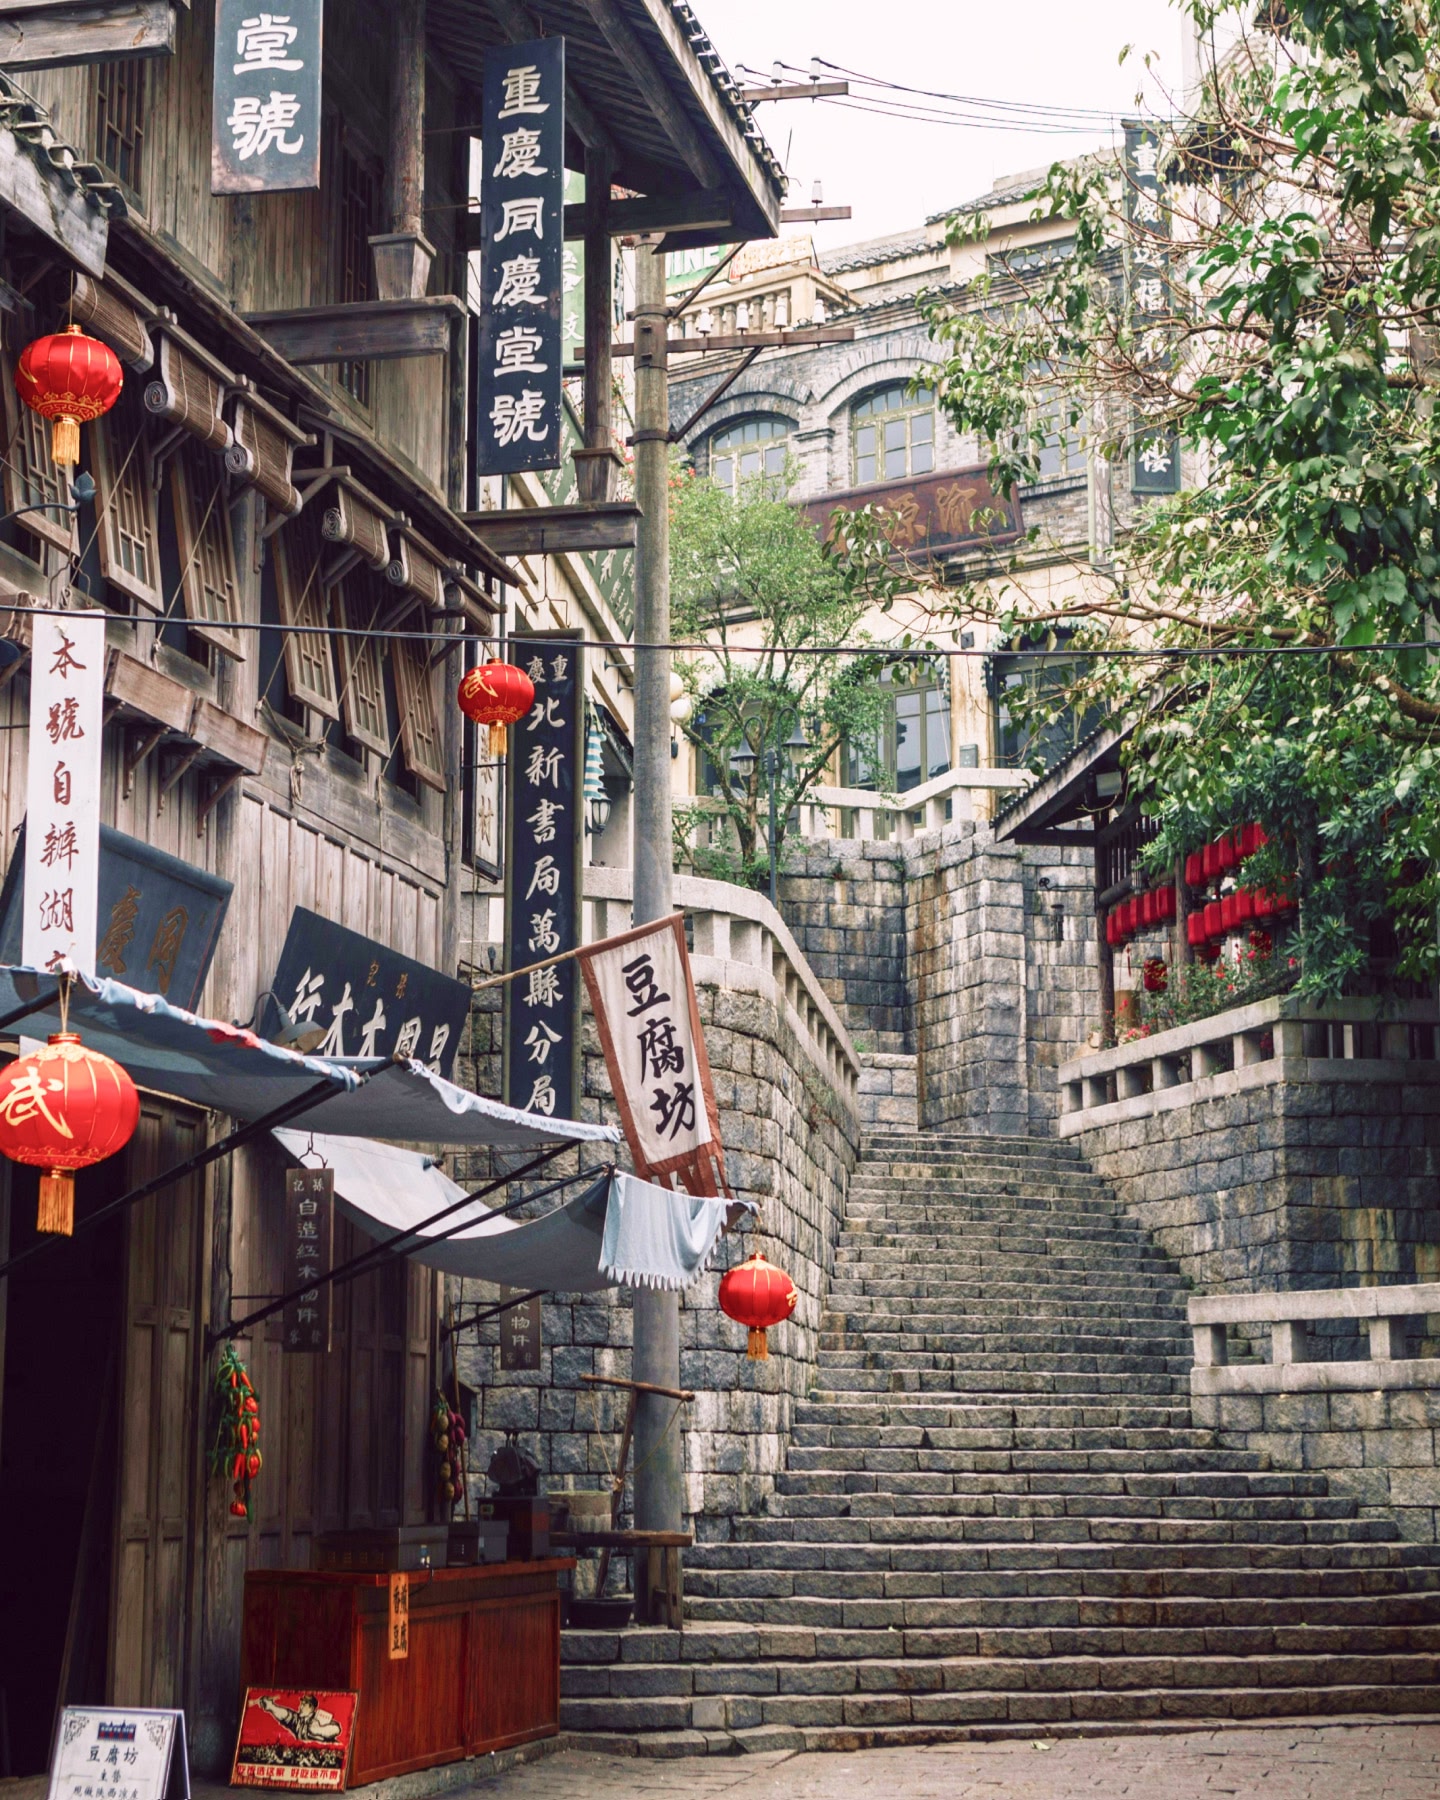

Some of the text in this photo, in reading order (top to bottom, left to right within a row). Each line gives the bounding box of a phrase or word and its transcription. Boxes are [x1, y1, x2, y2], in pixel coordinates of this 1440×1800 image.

[227, 13, 304, 161] 堂號
[488, 65, 550, 447] 重慶同慶堂號
[522, 696, 566, 1116] 北新書局萬縣分局
[621, 953, 696, 1142] 豆腐坊
[86, 1744, 139, 1766] 豆腐坊
